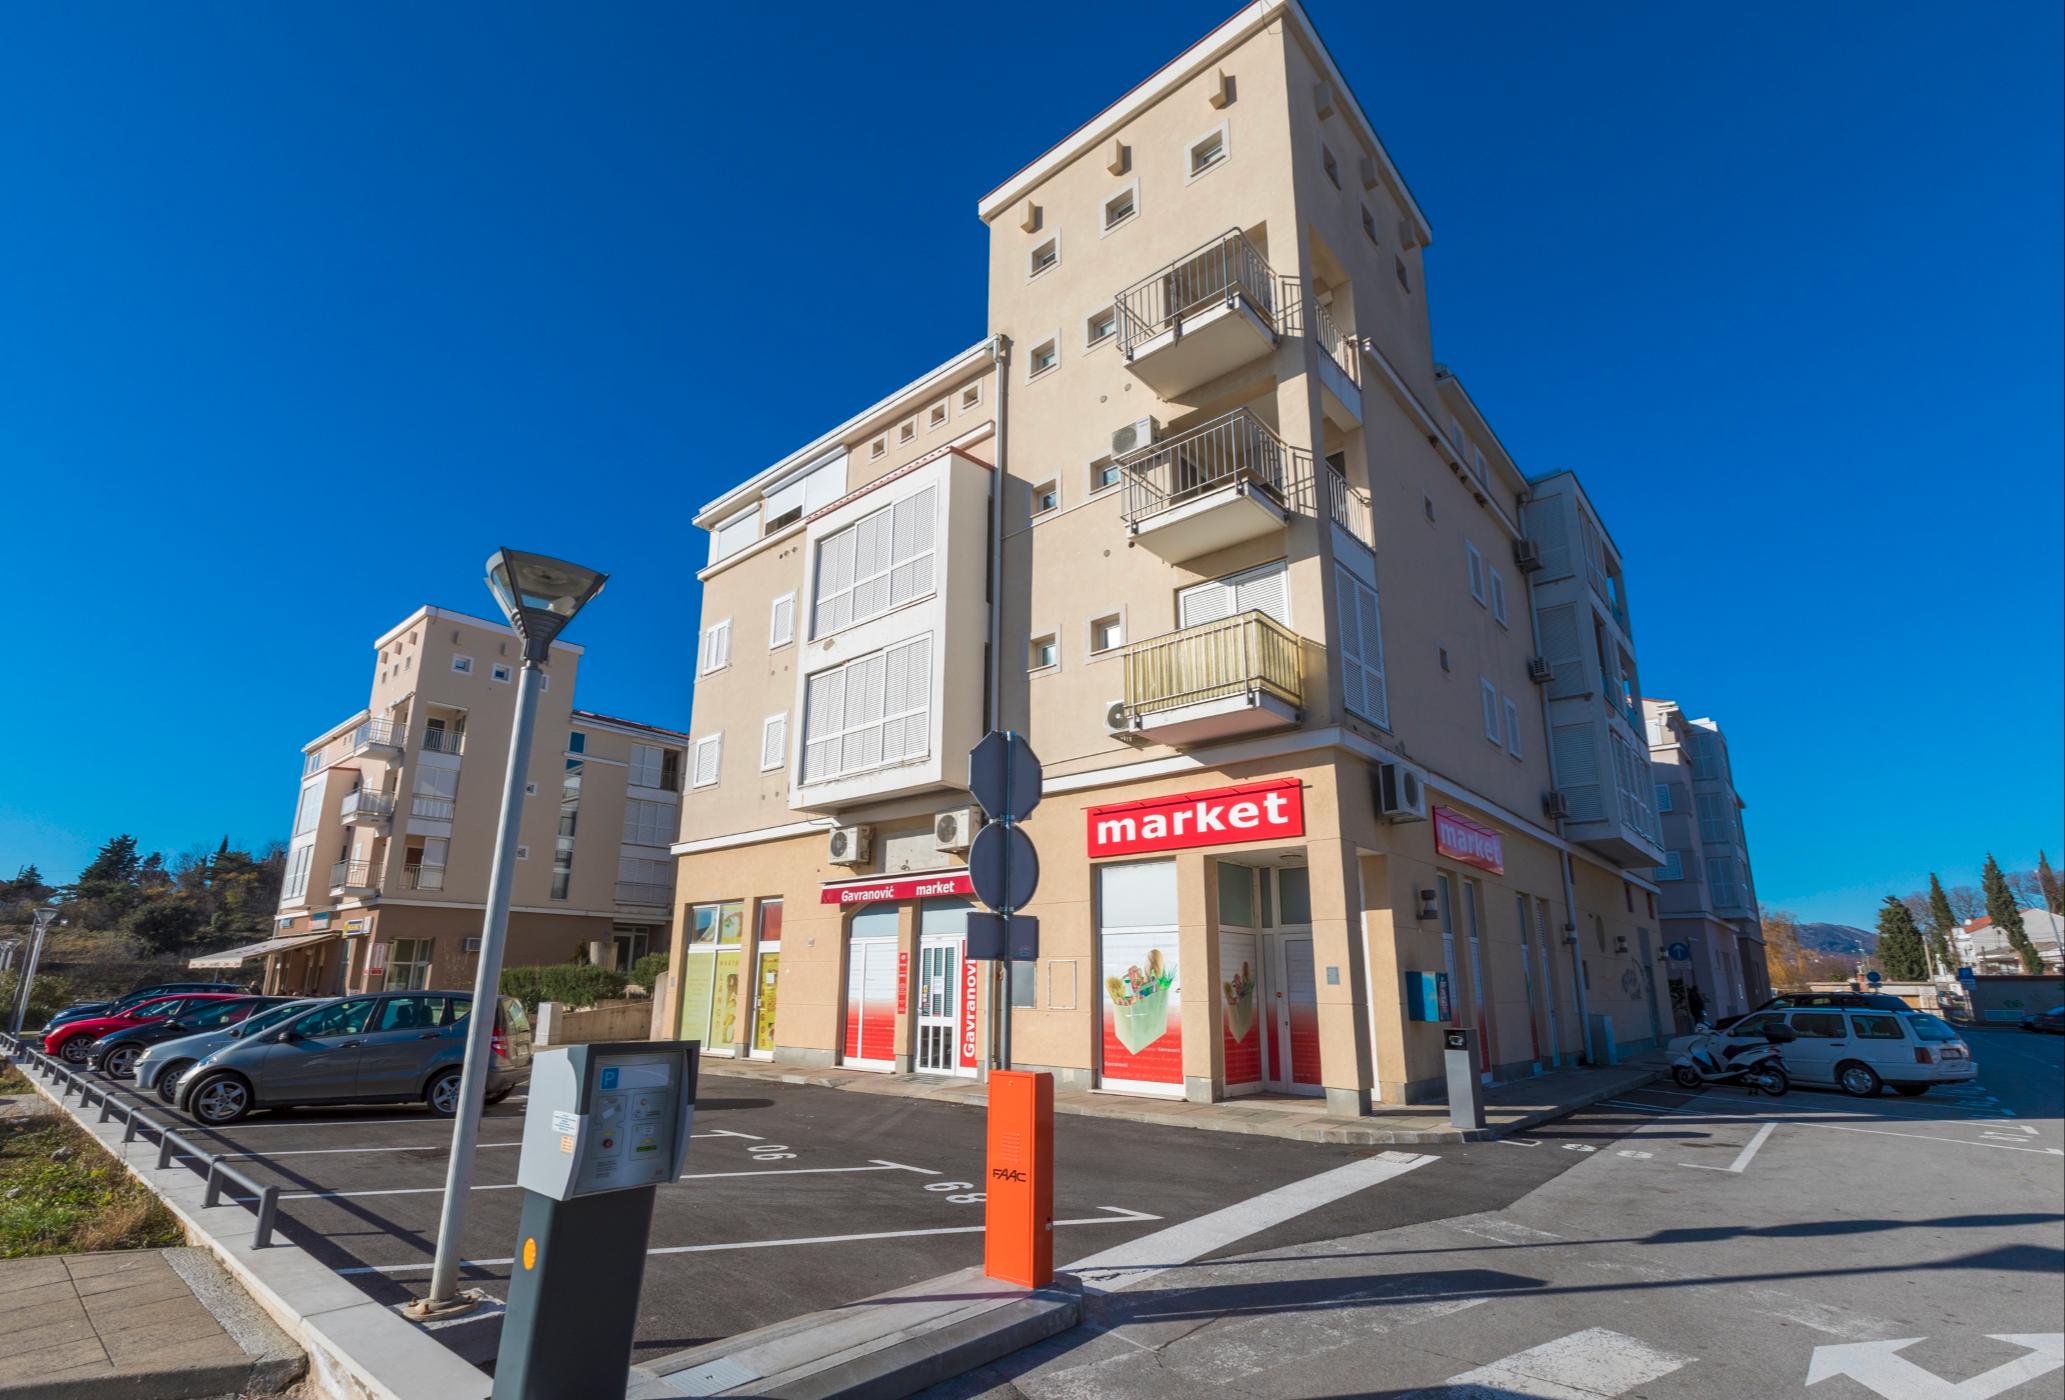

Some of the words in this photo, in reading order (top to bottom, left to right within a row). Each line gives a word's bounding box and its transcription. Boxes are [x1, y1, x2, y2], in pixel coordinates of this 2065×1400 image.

[1097, 791, 1289, 845] market
[1439, 821, 1503, 865] market
[841, 886, 895, 902] Gavranović
[915, 880, 955, 896] market
[963, 958, 977, 1058] Gavranovi
[992, 1168, 1027, 1183] FAAC
